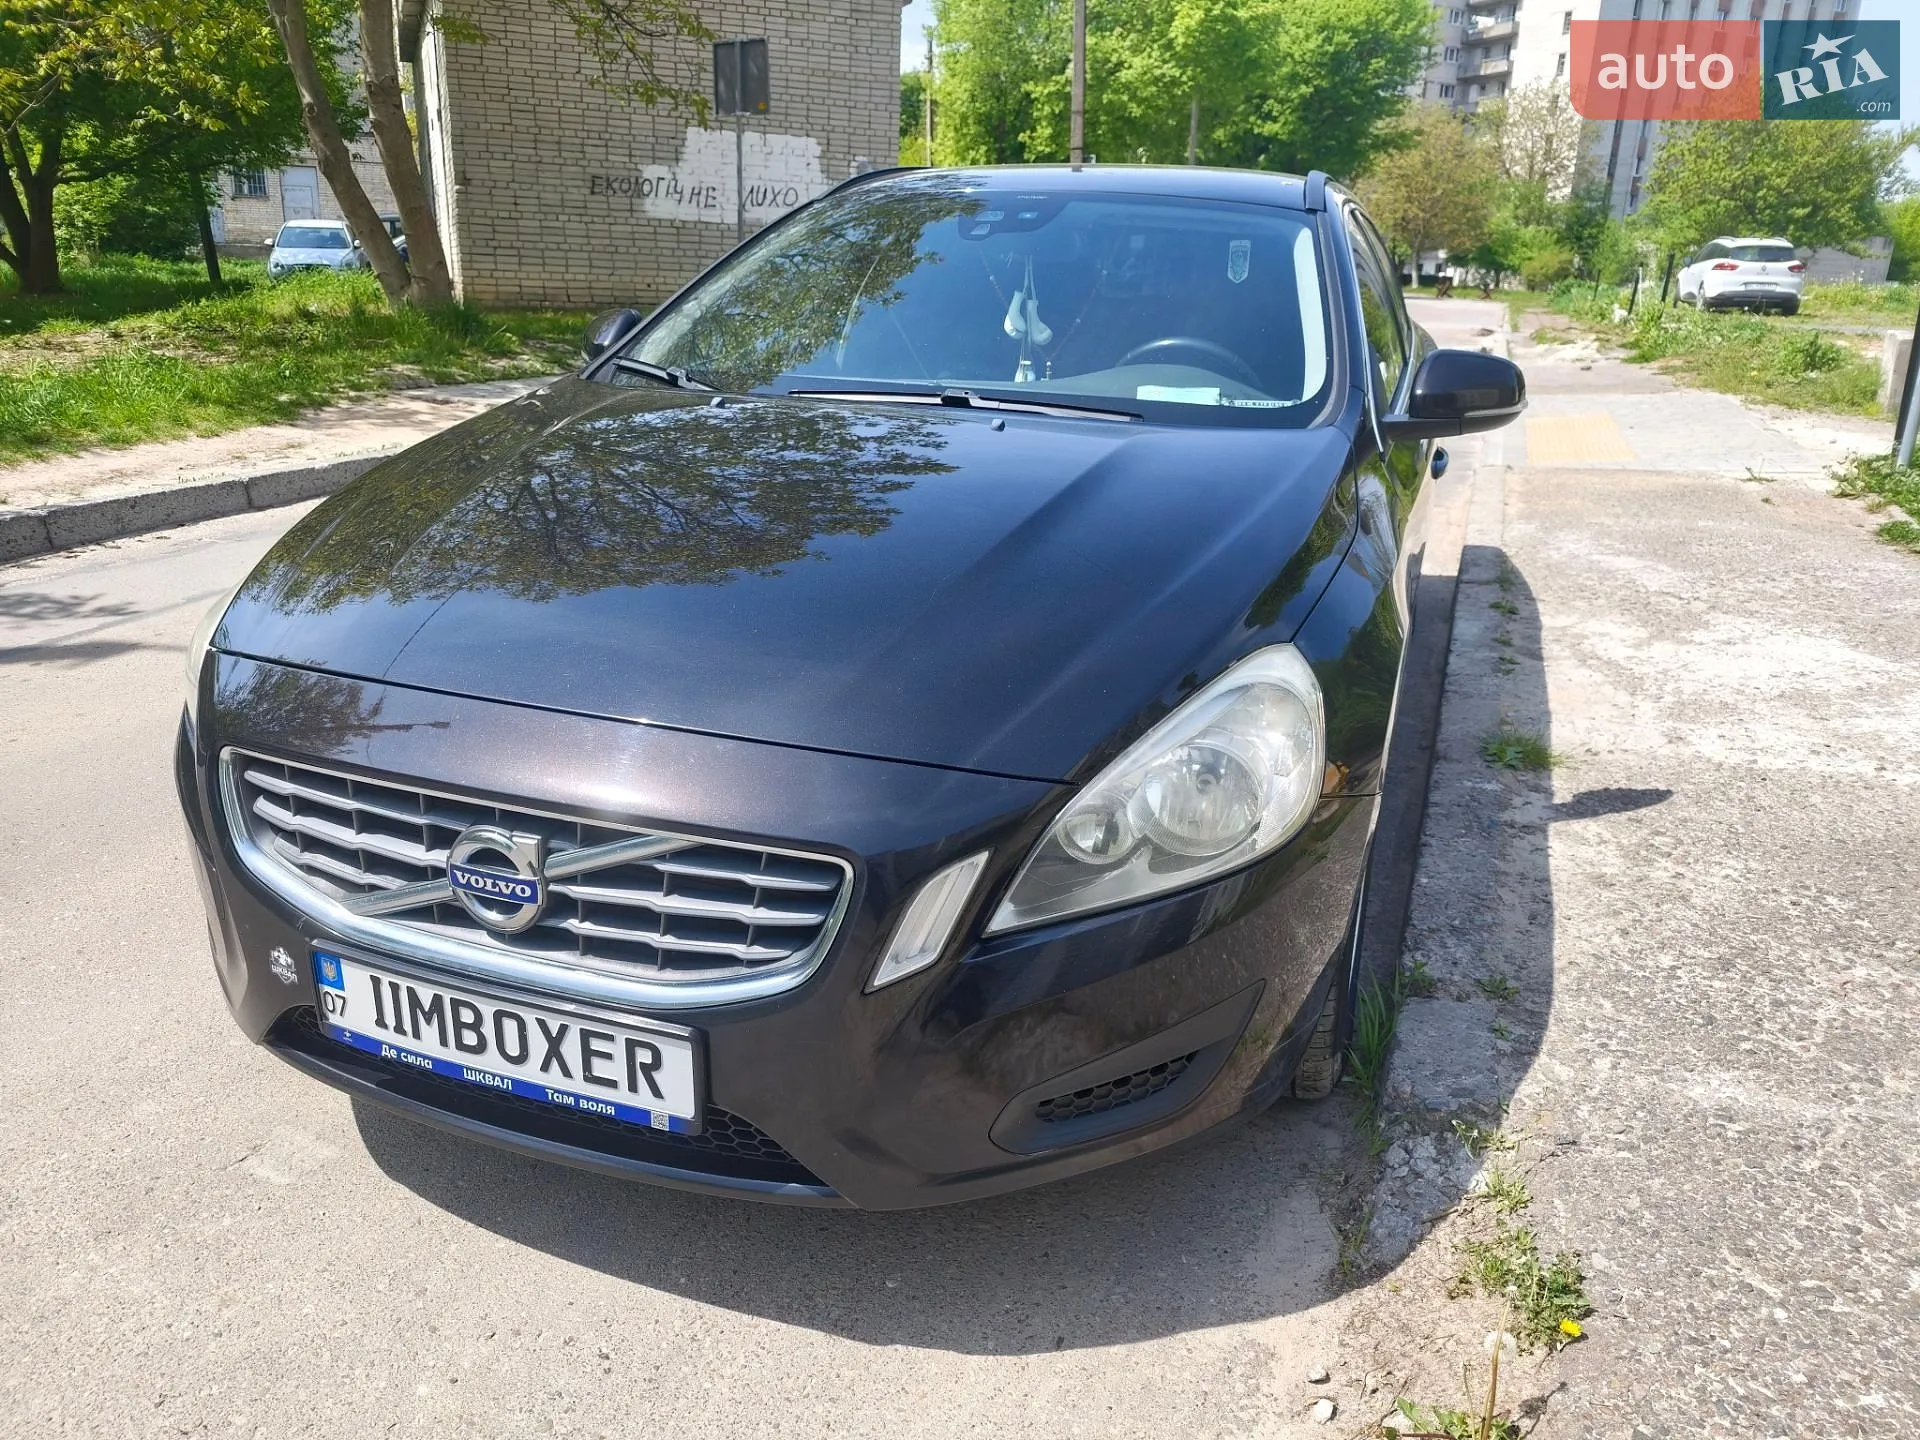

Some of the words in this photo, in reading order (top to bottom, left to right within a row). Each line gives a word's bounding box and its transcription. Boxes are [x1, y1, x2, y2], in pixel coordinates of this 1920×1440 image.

[742, 185, 799, 212] ЛИХО
[453, 869, 532, 897] VOLVO
[323, 990, 347, 1017] 07
[381, 1044, 398, 1059] Де
[400, 1051, 433, 1070] сила
[463, 1067, 513, 1091] ШКВАЛ
[545, 1088, 576, 1106] Там
[579, 1099, 616, 1116] воля
